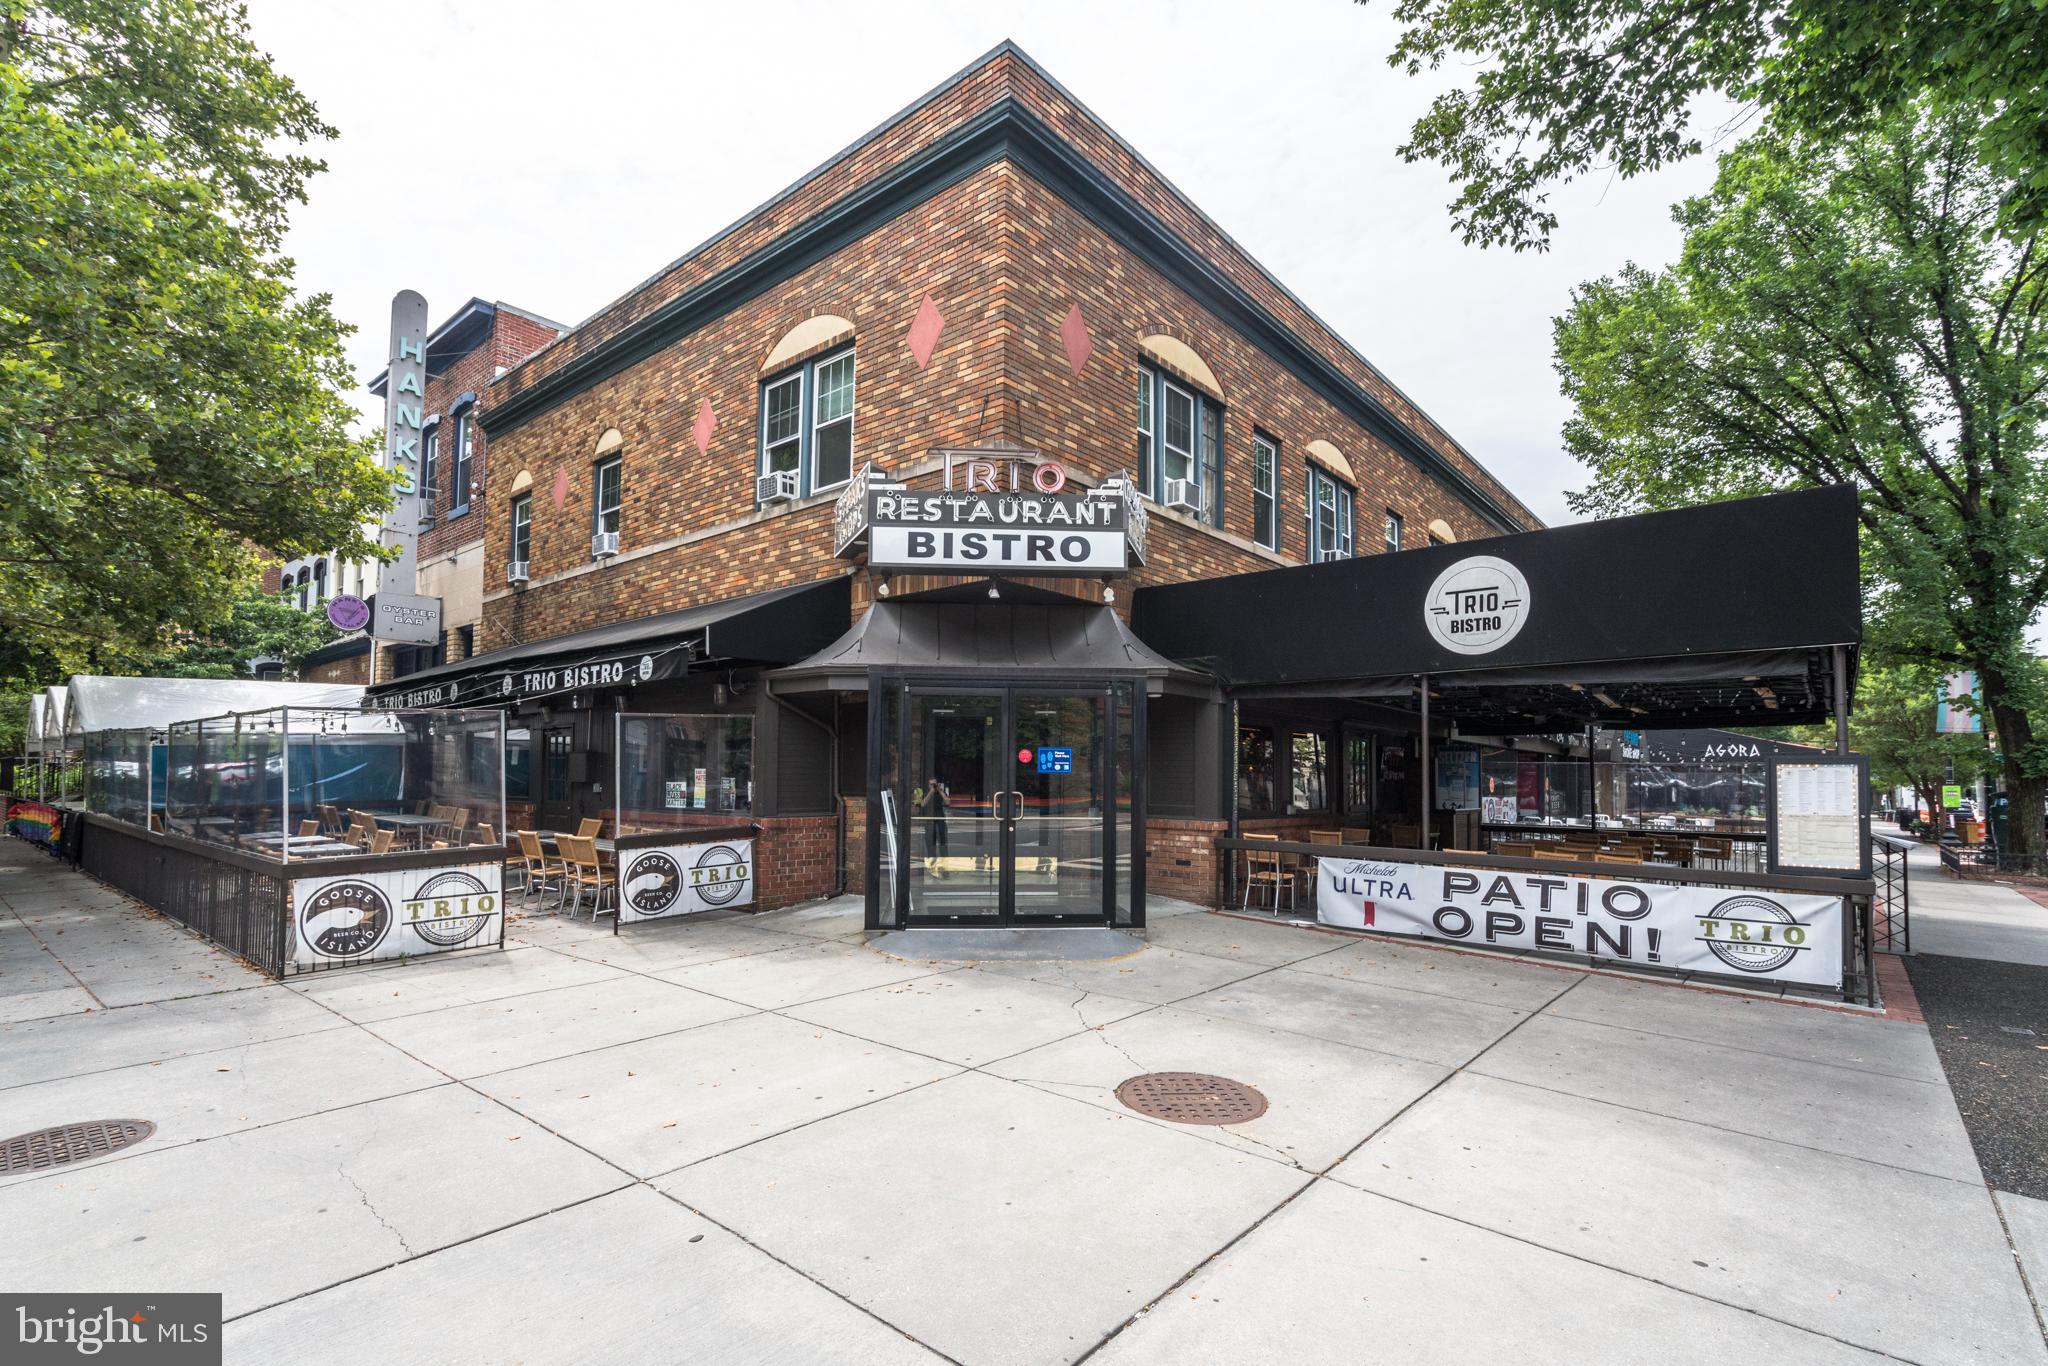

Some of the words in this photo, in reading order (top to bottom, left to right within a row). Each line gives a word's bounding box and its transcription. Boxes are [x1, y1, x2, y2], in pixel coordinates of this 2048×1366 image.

[394, 336, 422, 494] HANKS
[926, 448, 1067, 493] TRIO
[876, 495, 1117, 525] RESTAURANT
[907, 531, 1092, 562] BISTRO
[382, 604, 436, 618] OYSTER
[1445, 586, 1499, 615] TRIO
[394, 615, 424, 626] BAR
[1450, 616, 1502, 634] BISTRO
[524, 671, 556, 692] TRIO
[564, 661, 623, 688] BISTRO
[384, 695, 404, 709] TRIO
[407, 688, 442, 708] BISTRO
[1704, 744, 1761, 757] AGORA
[666, 798, 686, 806] MATTER
[636, 858, 671, 873] GOOSE
[691, 864, 748, 885] TRIO
[1343, 861, 1397, 877] Michelob
[319, 888, 374, 907] GOOSE
[706, 883, 735, 892] BISTRO
[1333, 875, 1413, 900] ULTRA
[1443, 871, 1653, 920] PATIO
[406, 895, 495, 921] TRIO
[635, 891, 672, 909] ISLAND
[430, 918, 475, 930] BISTRO
[1432, 906, 1662, 962] OPEN!
[1699, 919, 1806, 945] TRIO
[320, 930, 375, 952] ISLAND
[1726, 944, 1779, 955] BISTRO
